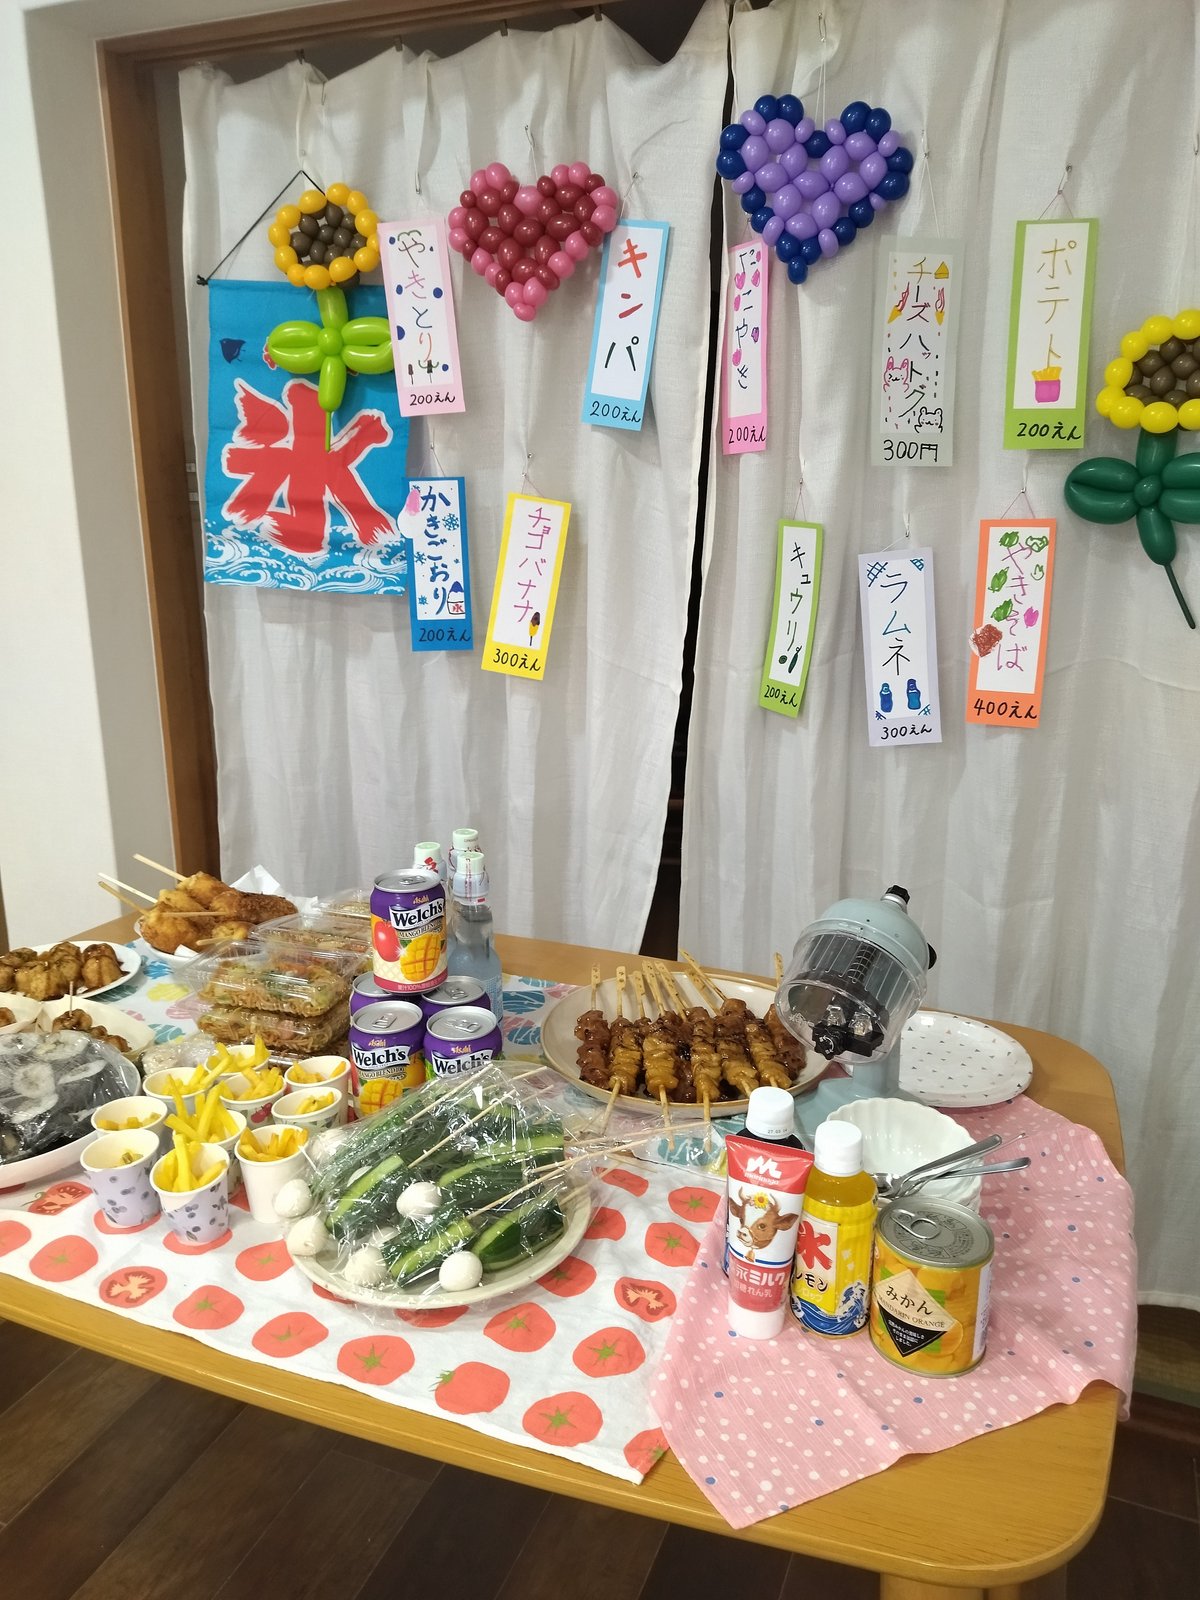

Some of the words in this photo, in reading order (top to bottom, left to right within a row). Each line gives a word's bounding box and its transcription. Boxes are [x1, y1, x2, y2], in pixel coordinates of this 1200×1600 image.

[398, 232, 433, 361] やきとり
[604, 238, 648, 371] キンパ
[1036, 238, 1077, 368] ポテト
[897, 257, 933, 418] チーズハットグ
[409, 392, 456, 407] 200えん
[590, 400, 641, 423] 200えん
[728, 425, 766, 444] 200えん
[1016, 421, 1082, 441] 200えん
[882, 439, 939, 462] 300円
[221, 377, 397, 555] 氷
[420, 486, 452, 615] かきごおり
[513, 507, 552, 622] チョコバナナ
[786, 541, 812, 651] キュウリ
[998, 542, 1034, 671] やきそば
[418, 627, 471, 643] 200えん
[880, 573, 912, 675] ラムネ
[493, 648, 541, 672] 300えん
[763, 684, 798, 708] 200えん
[973, 697, 1038, 720] 400えん
[880, 723, 933, 740] 300えん
[391, 902, 444, 927] Welch's
[368, 1038, 386, 1047] Asahi
[451, 1044, 472, 1054] Asahi
[353, 1048, 406, 1067] Welch's
[434, 1052, 490, 1075] Welch's
[879, 1295, 911, 1321] MANDARIN
[911, 1317, 946, 1329] ORANGE
[885, 1286, 934, 1316] みかん
